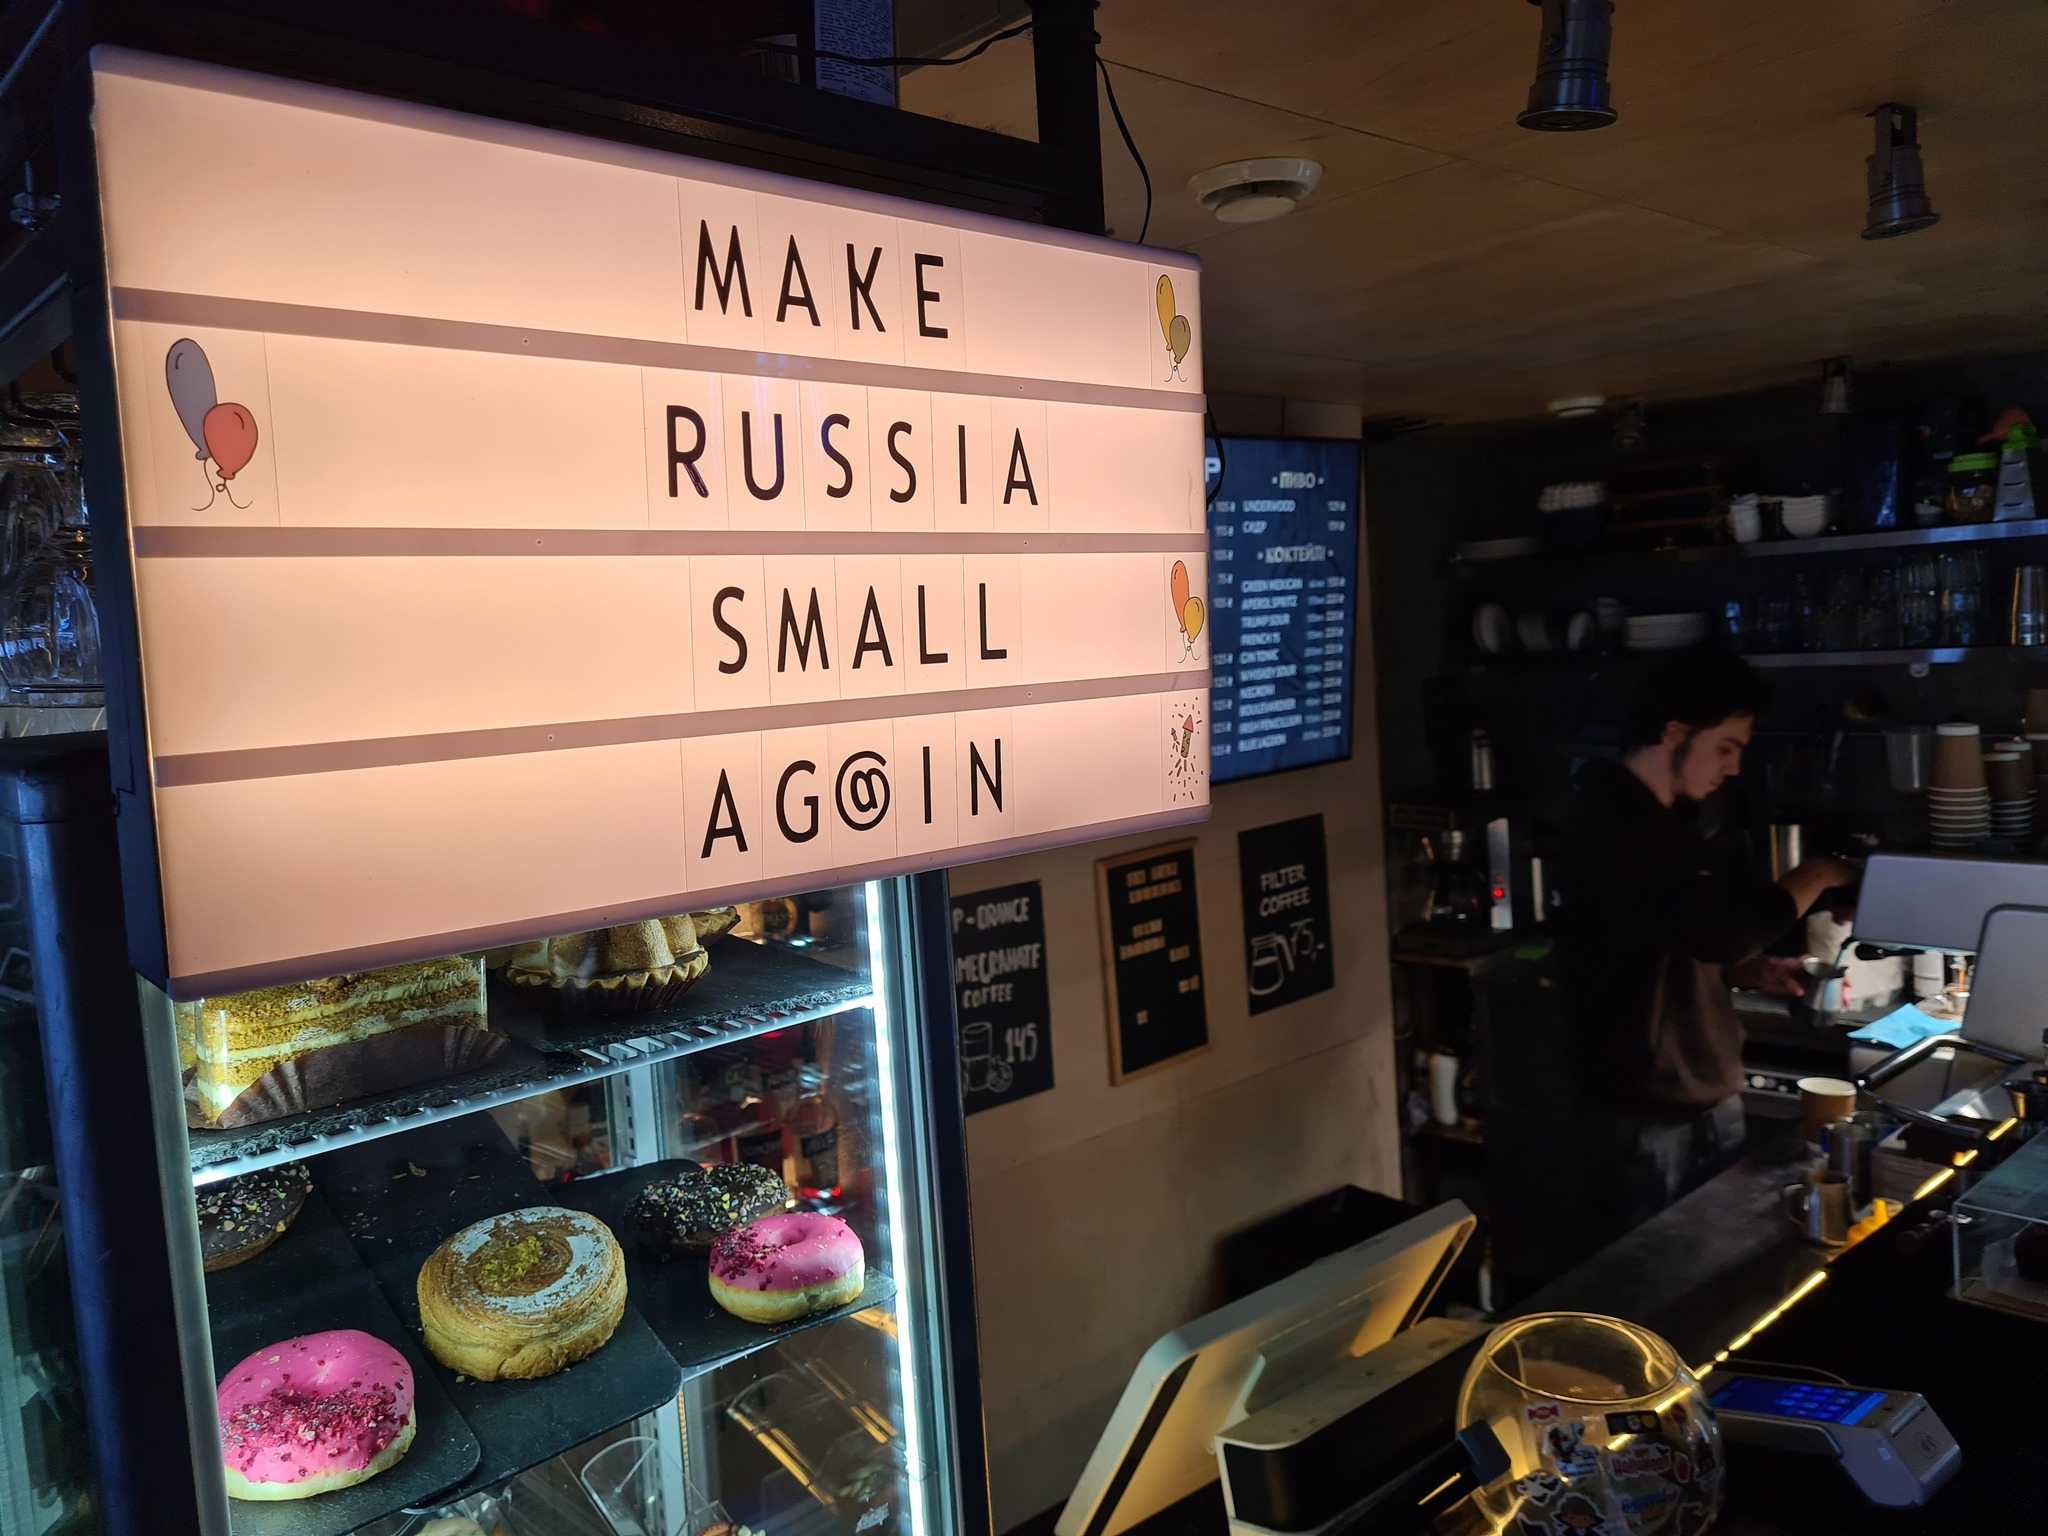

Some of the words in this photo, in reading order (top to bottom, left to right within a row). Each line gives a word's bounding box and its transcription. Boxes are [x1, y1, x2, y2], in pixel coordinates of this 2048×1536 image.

[694, 219, 949, 339] MAKE
[666, 405, 1039, 506] RUSSIA
[712, 583, 1007, 675] SMALL
[700, 738, 1003, 859] AG@IN
[1259, 886, 1312, 918] COFFEE
[1260, 863, 1307, 892] FILTER
[962, 982, 1014, 1008] COFFEE
[1005, 1022, 1039, 1064] 145
